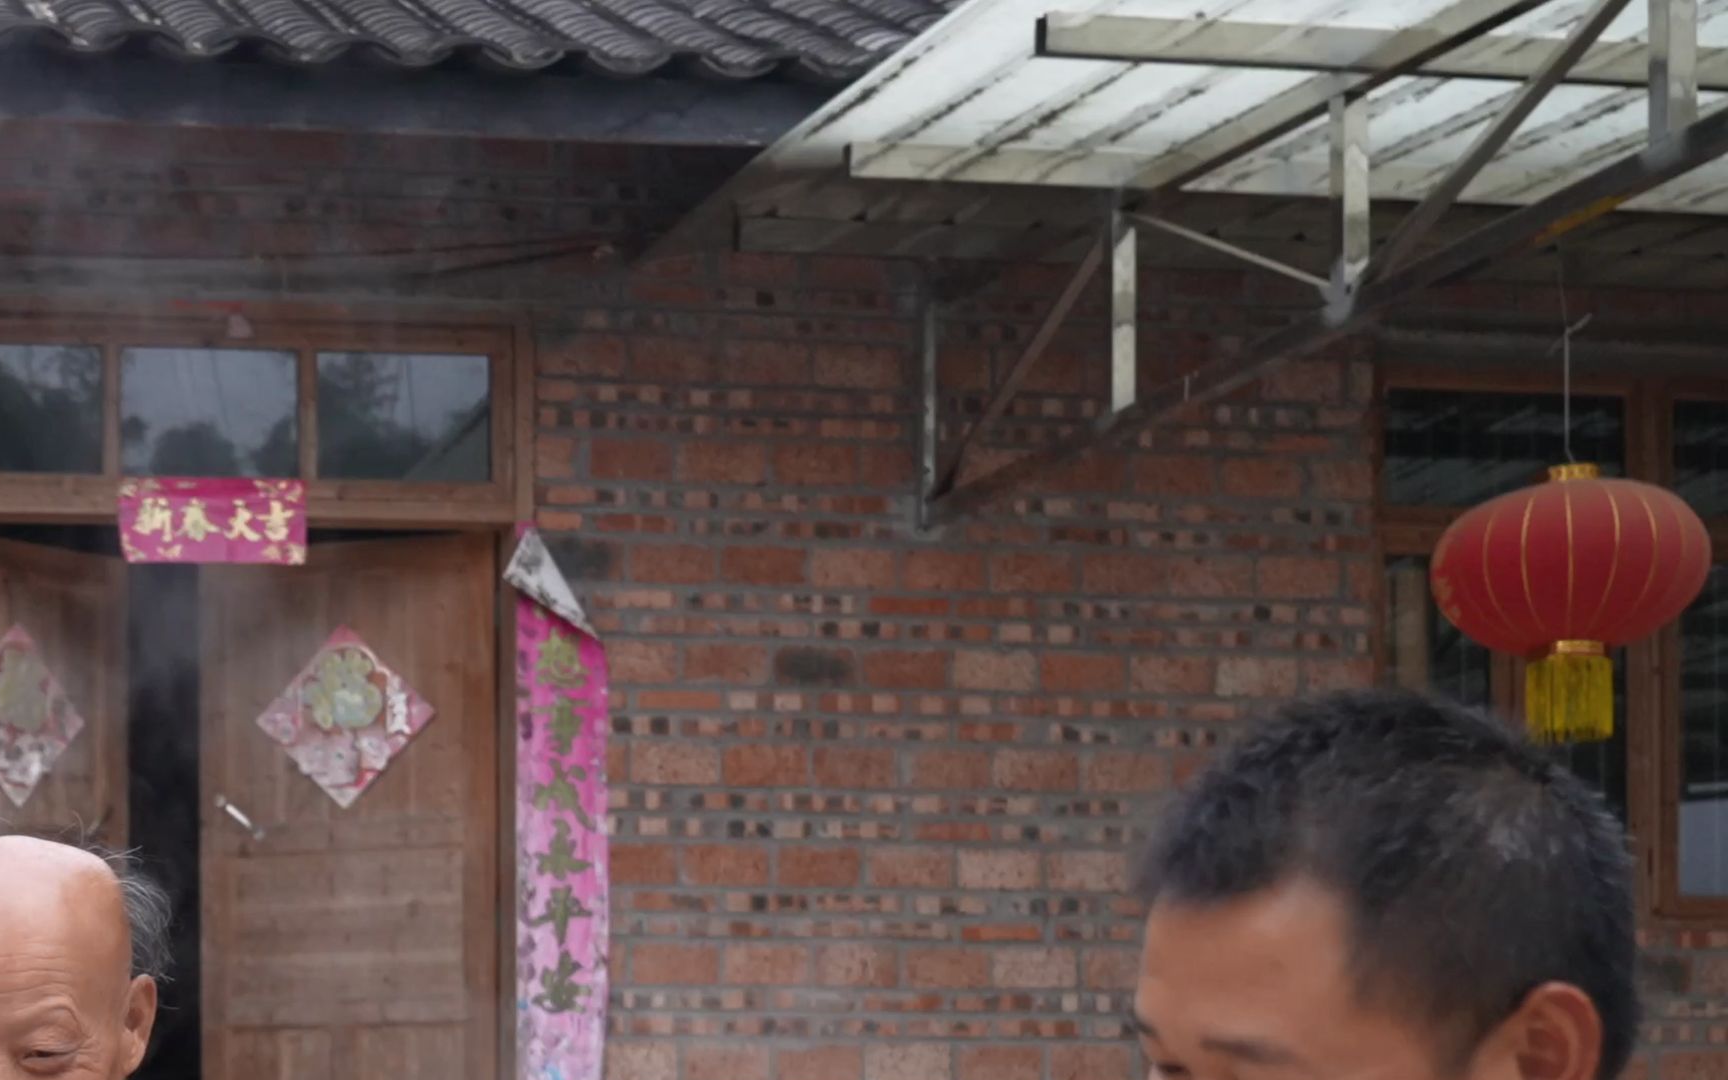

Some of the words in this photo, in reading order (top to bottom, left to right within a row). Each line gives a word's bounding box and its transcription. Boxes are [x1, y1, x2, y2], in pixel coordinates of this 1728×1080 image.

[132, 497, 295, 542] 新春大吉
[530, 603, 597, 1014] 想事成永平安
